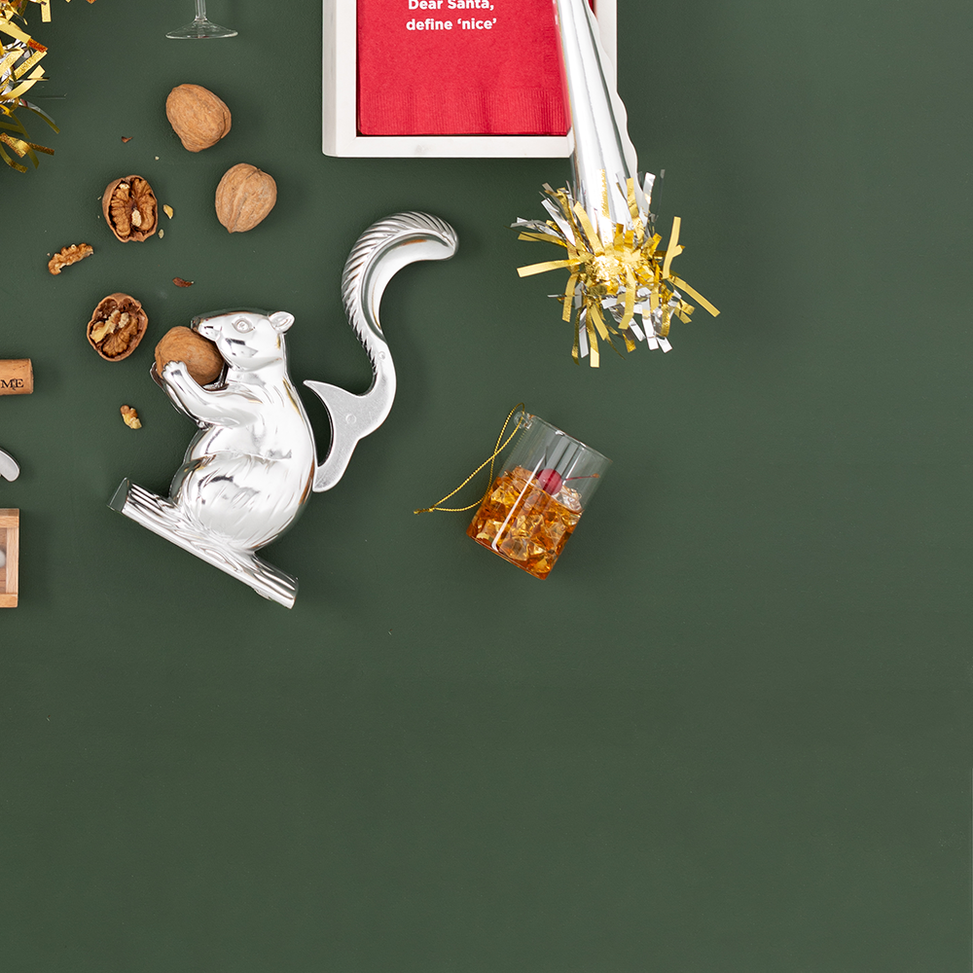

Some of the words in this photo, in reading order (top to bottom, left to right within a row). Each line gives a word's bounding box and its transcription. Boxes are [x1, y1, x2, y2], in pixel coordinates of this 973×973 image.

[405, 17, 454, 31] define
[457, 17, 497, 30] ‘nice’
[0, 378, 25, 389] ME
